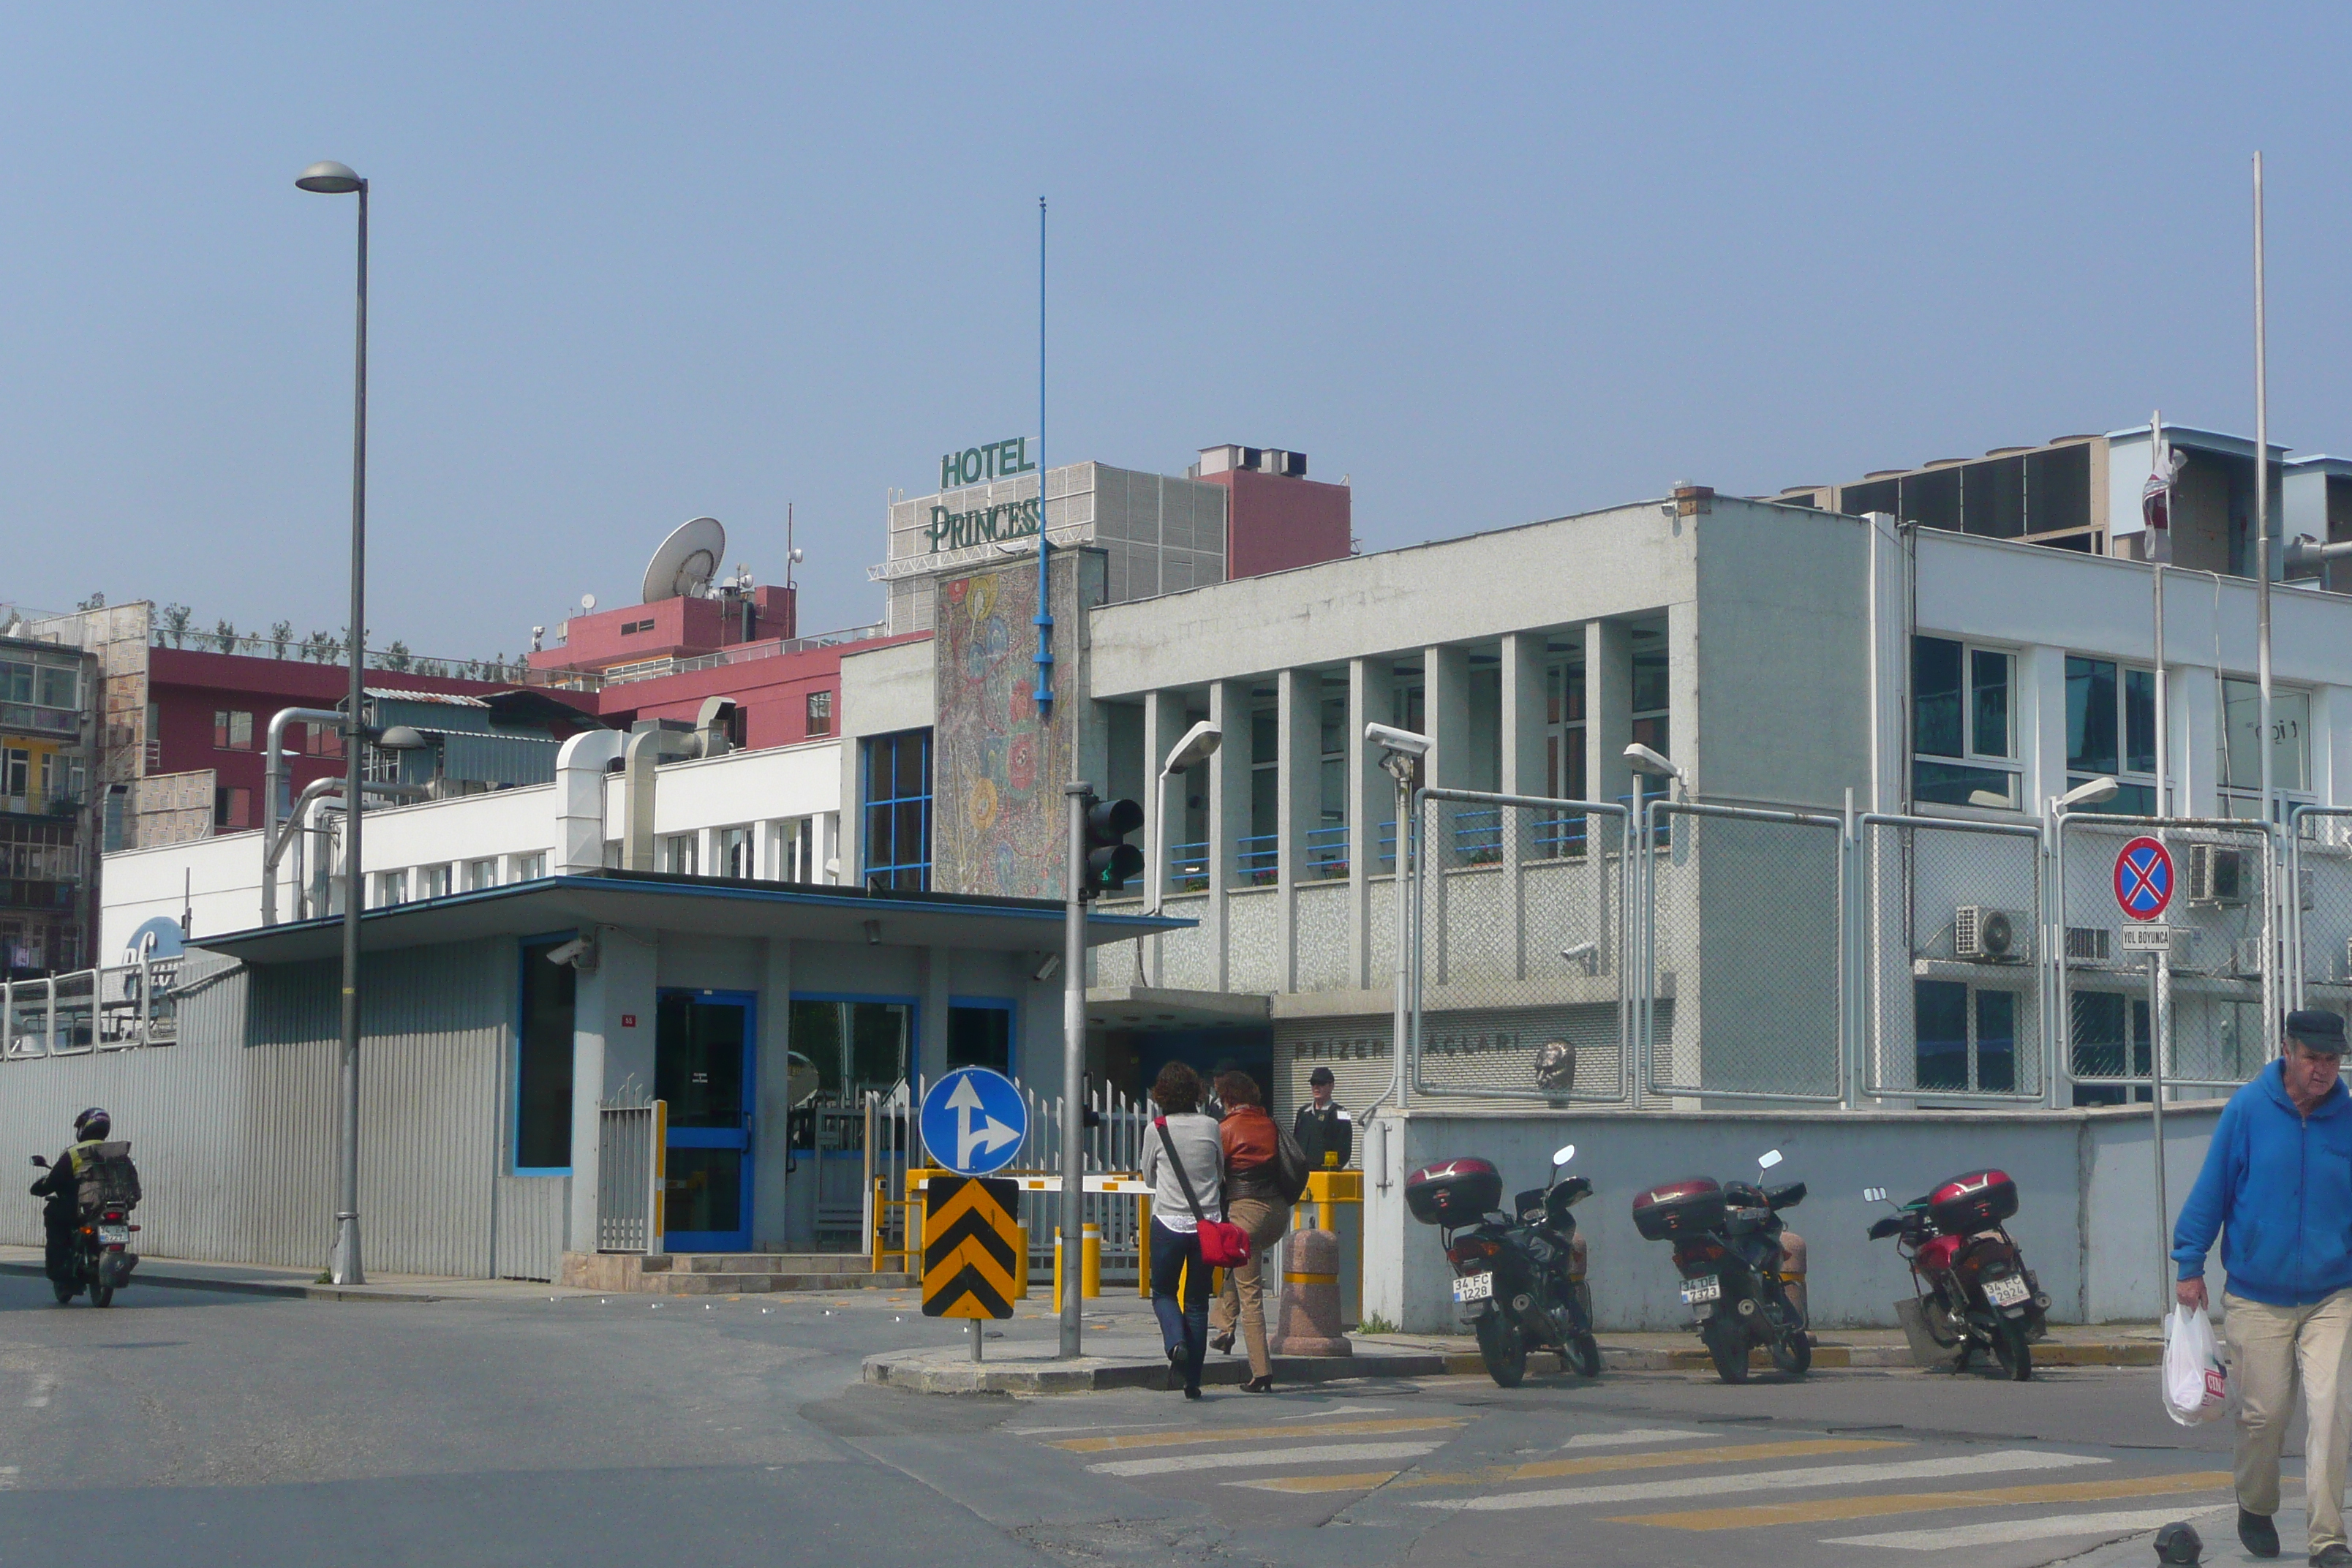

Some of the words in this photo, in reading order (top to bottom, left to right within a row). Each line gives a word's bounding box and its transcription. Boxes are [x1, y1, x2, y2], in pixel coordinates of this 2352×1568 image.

[941, 437, 1035, 489] HOTEL
[2123, 932, 2136, 944] YOL
[2138, 931, 2168, 944] BOYUNCA
[1455, 1279, 1469, 1290] 34
[1473, 1275, 1488, 1286] FC
[1682, 1281, 1696, 1291] 34
[1986, 1283, 2001, 1294] 34
[2004, 1275, 2021, 1289] FC
[1463, 1286, 1488, 1300] 1228
[1690, 1287, 1716, 1301] 7373
[1997, 1286, 2024, 1301] 2924
